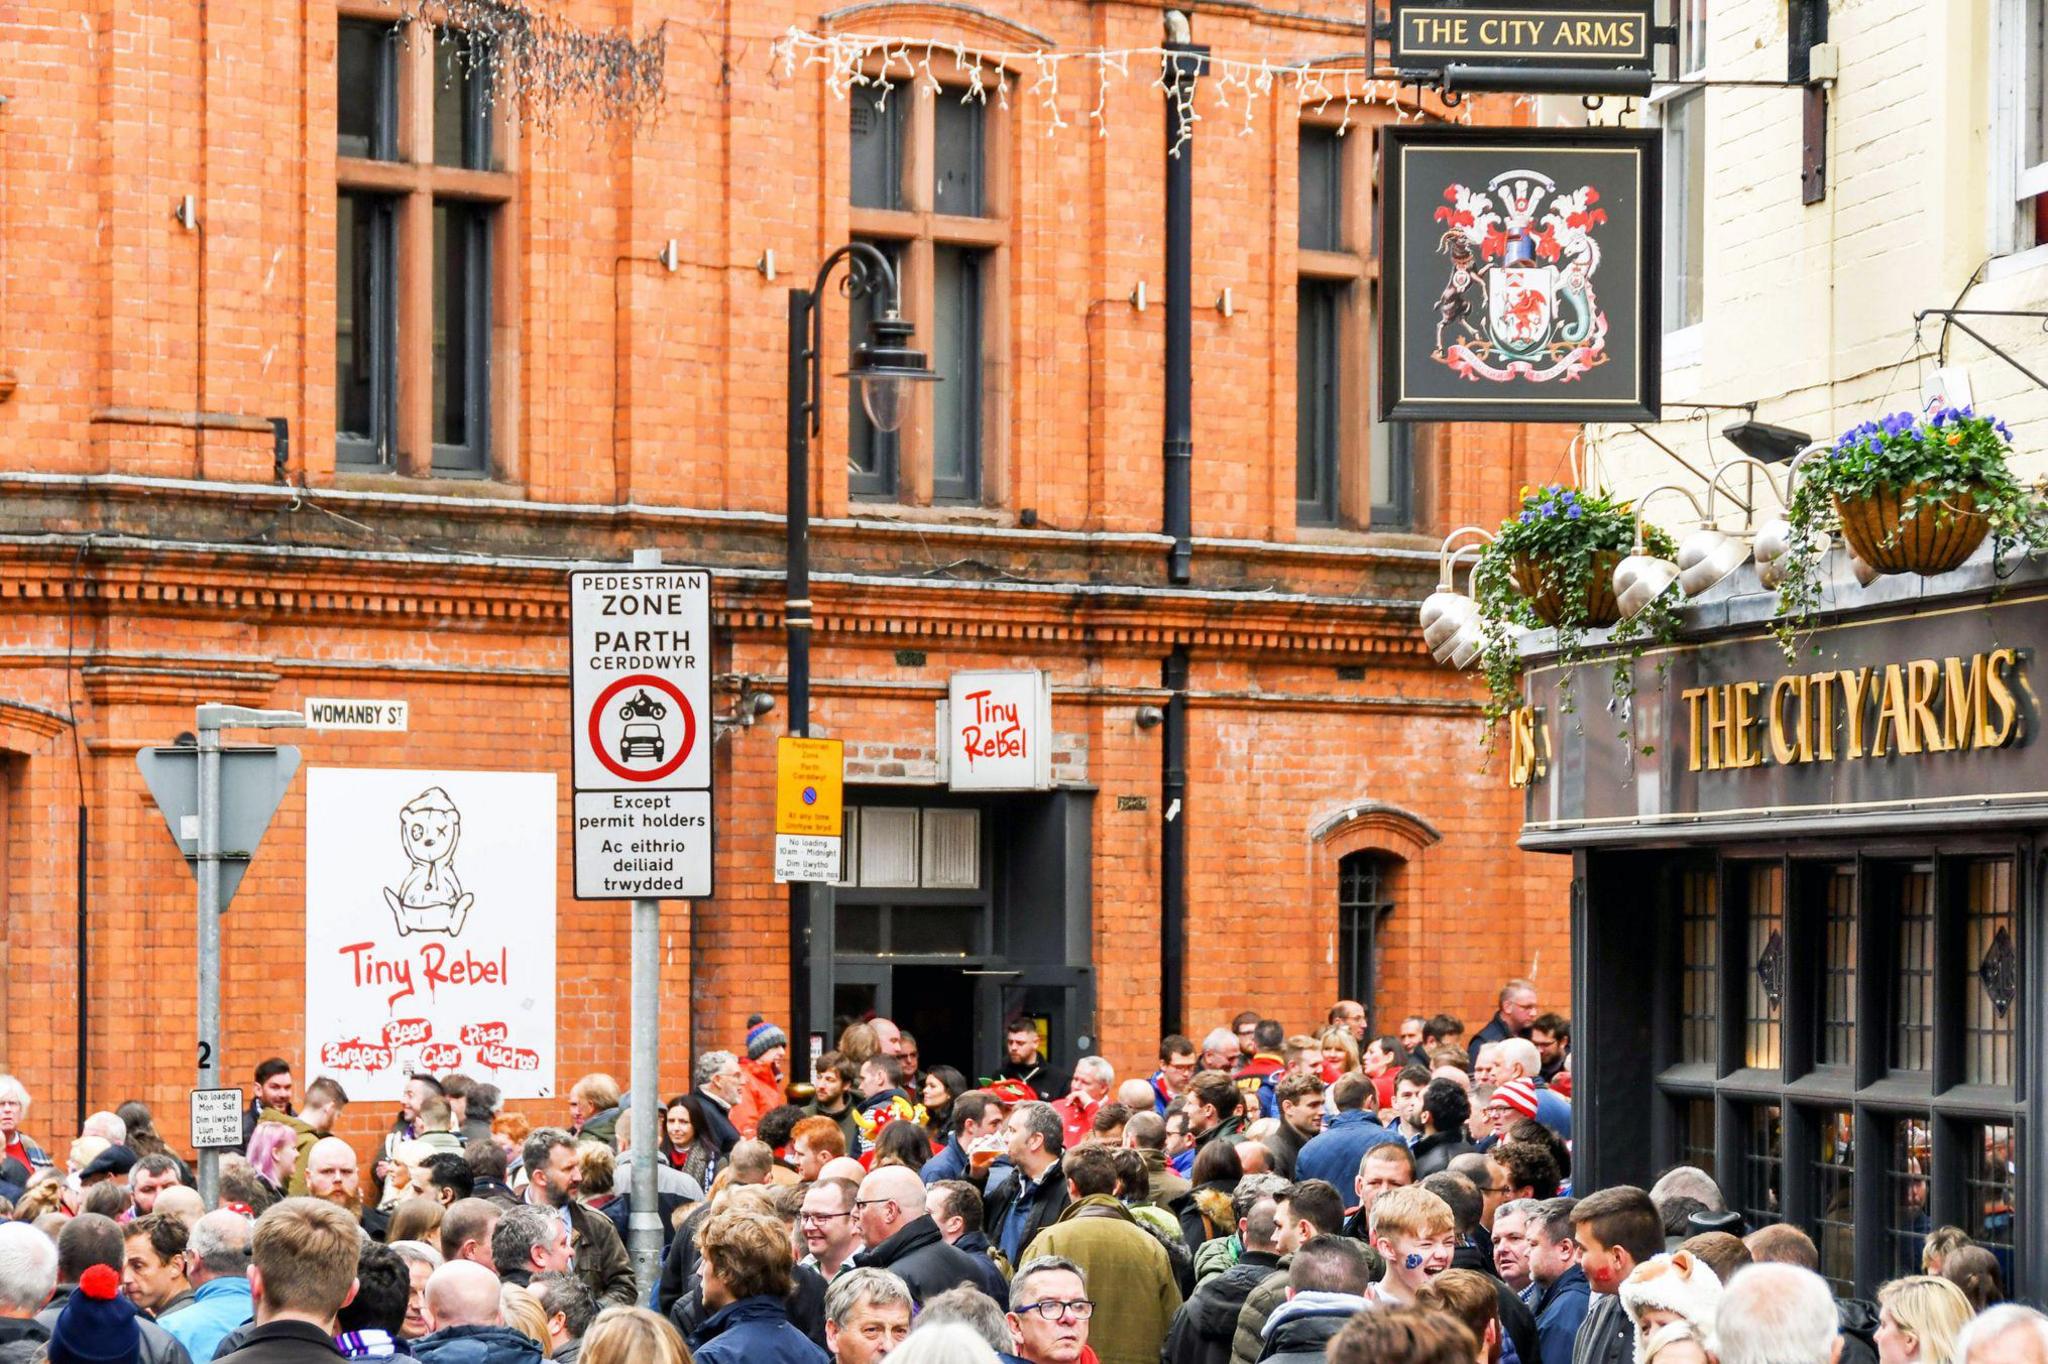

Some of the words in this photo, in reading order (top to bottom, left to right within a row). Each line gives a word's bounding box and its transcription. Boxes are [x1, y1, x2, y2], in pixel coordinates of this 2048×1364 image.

[1413, 19, 1468, 44] THE
[1479, 20, 1545, 46] CITY
[1553, 22, 1634, 47] ARMS
[582, 576, 701, 590] PEDESTRIAN
[602, 595, 682, 615] ZONE
[594, 631, 690, 652] PARTH
[590, 656, 696, 670] CERDDWYR
[311, 703, 382, 724] WOMANBY
[965, 690, 1021, 738] Tiny
[1681, 681, 1761, 771] THE
[1770, 667, 1872, 765] CITY
[1872, 649, 2016, 757] ARMS
[962, 725, 1026, 764] Rebel
[614, 795, 671, 811] Except
[579, 814, 635, 830] permit
[643, 813, 705, 827] holders
[601, 840, 623, 853] Ac
[631, 840, 685, 853] eithrio
[789, 838, 800, 846] No
[802, 839, 827, 848] loading
[779, 847, 798, 855] 10am
[807, 848, 836, 858] Midnight
[613, 858, 673, 872] deiliaid
[786, 859, 800, 867] Dim
[777, 868, 795, 876] 10am
[803, 869, 824, 877] Canol
[604, 876, 683, 891] trwydded
[339, 941, 415, 1010] Tiny
[420, 943, 507, 993] Rebel
[385, 1020, 431, 1048] Beer
[463, 1024, 505, 1046] Pizza
[198, 1041, 211, 1069] 2
[324, 1042, 391, 1071] Burgers
[421, 1044, 460, 1067] Cider
[481, 1045, 538, 1071] Nachos
[198, 1093, 208, 1101] No
[210, 1093, 236, 1101] loading
[199, 1103, 213, 1111] Mon
[223, 1102, 235, 1110] Sat
[196, 1115, 209, 1123] Dim
[223, 1125, 235, 1133] Sad
